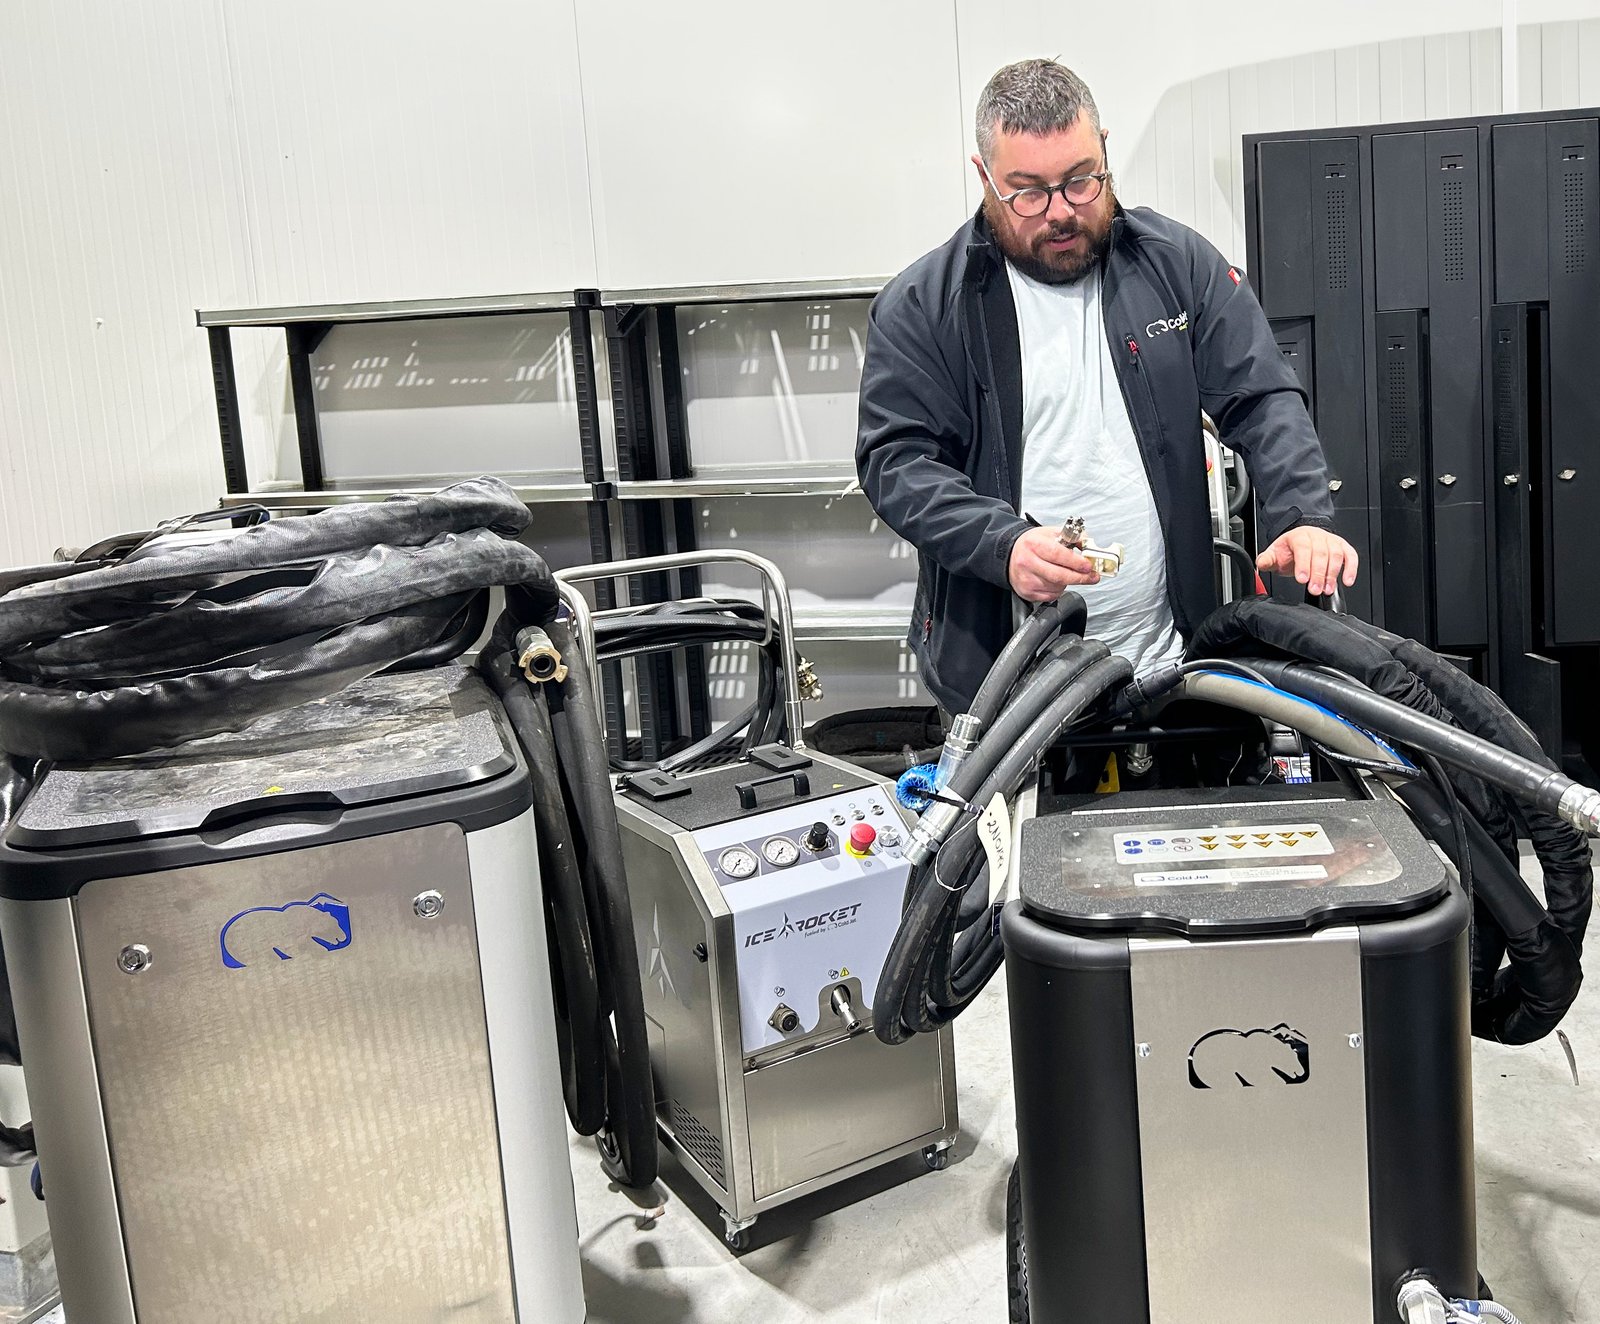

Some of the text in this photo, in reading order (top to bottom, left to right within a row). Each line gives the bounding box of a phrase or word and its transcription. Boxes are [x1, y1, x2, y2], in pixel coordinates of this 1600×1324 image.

[744, 903, 862, 948] ICE ROCKET
[804, 929, 820, 939] fueled
[838, 920, 849, 928] Cold
